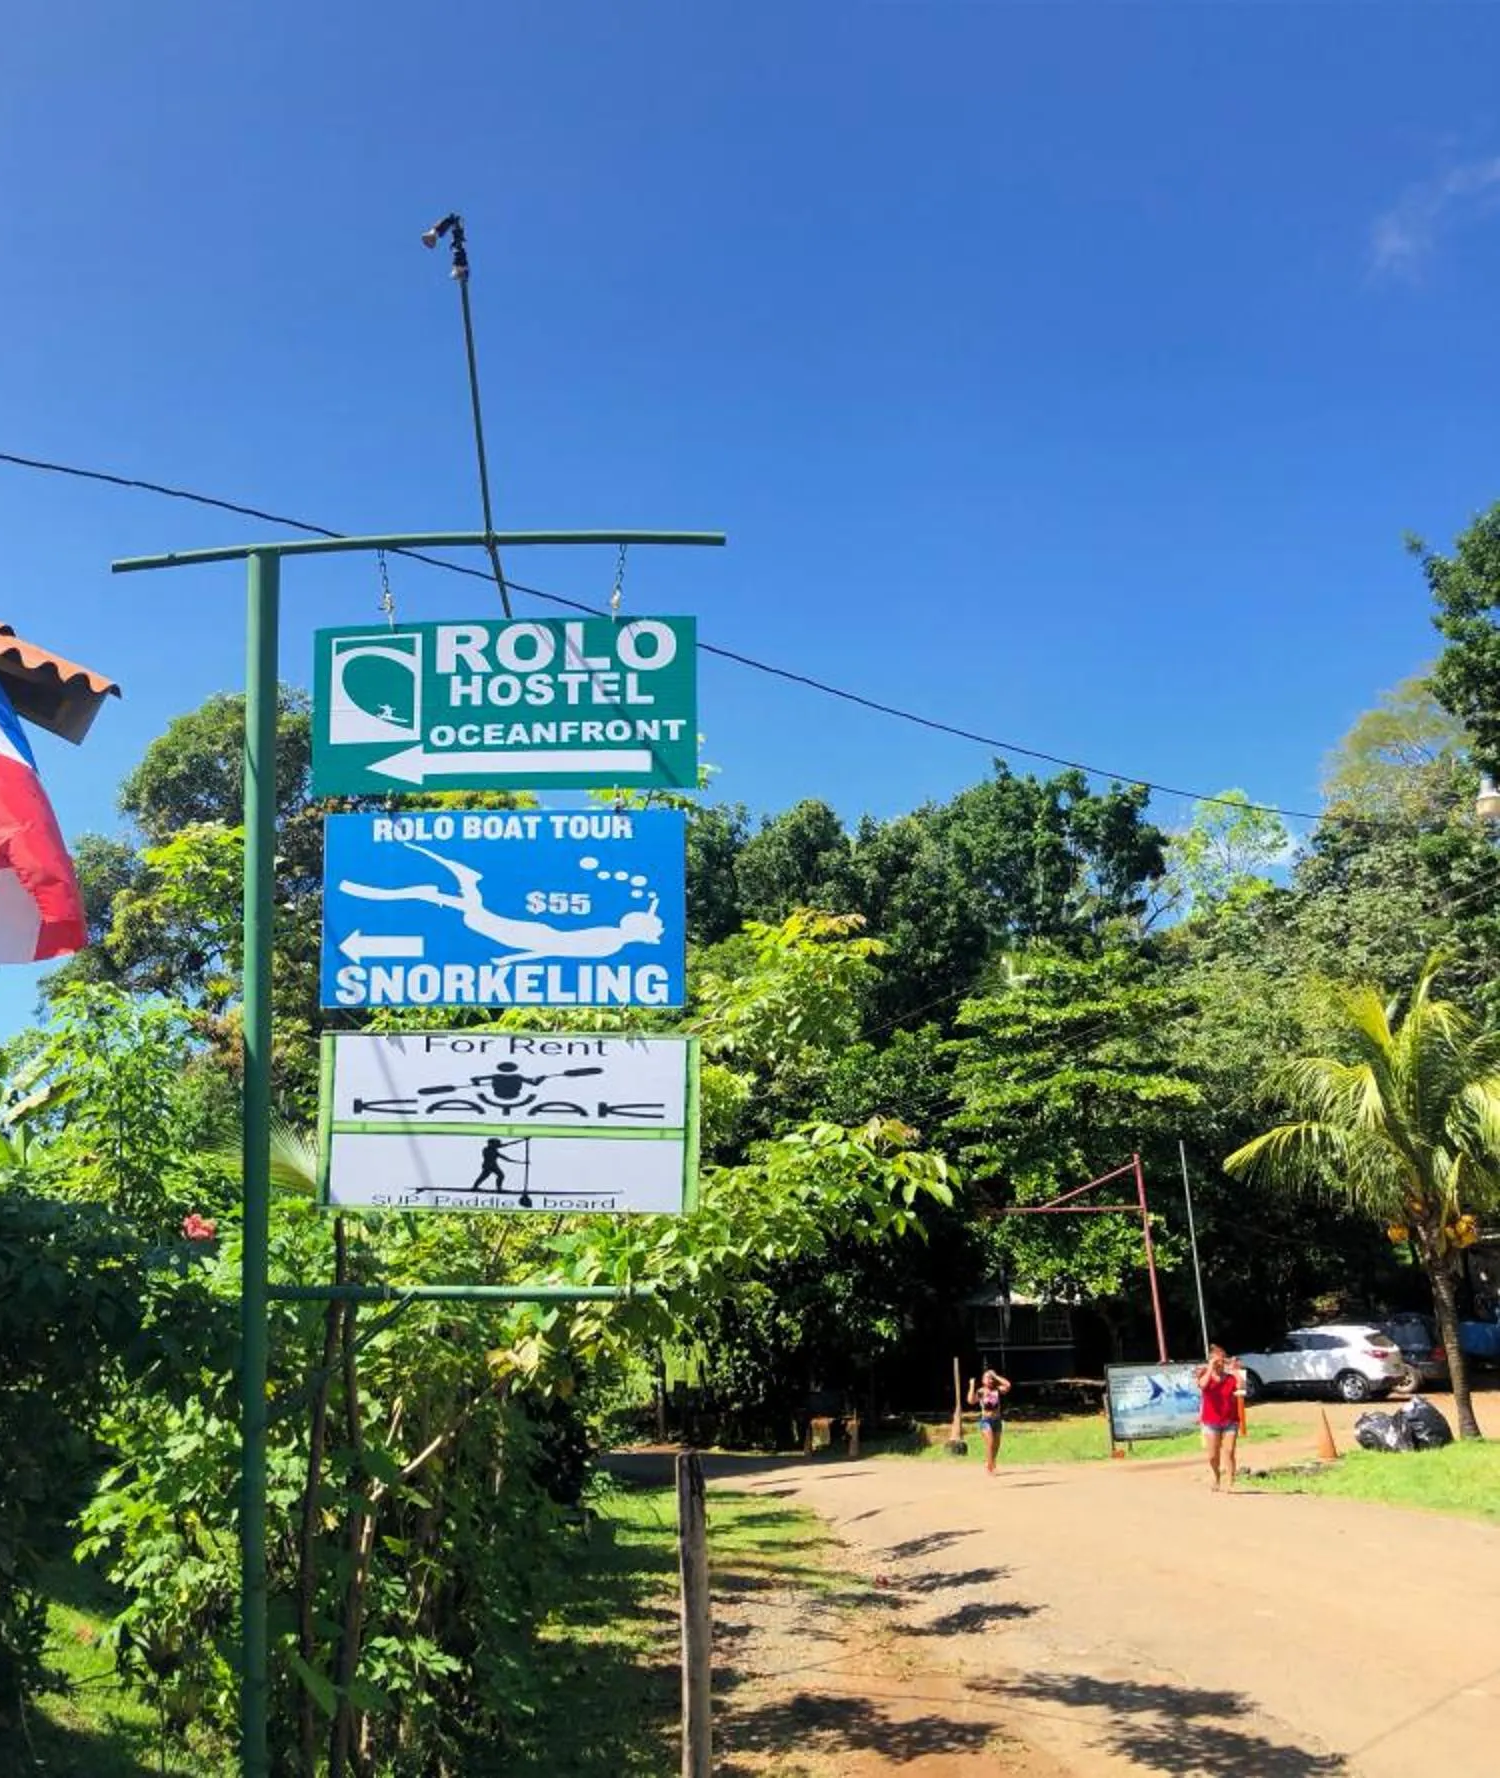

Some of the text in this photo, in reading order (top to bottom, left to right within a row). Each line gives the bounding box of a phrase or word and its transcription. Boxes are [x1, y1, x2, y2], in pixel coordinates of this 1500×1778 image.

[435, 619, 678, 674] ROLO
[449, 672, 655, 707] HOSTEL
[428, 718, 687, 747] OCEANFRONT
[372, 814, 634, 843] ROLO BOAT TOUR
[525, 890, 592, 915] $55
[334, 963, 669, 1006] SNORKELING
[424, 1034, 609, 1057] For Rent
[352, 1093, 666, 1119] KAYAK
[371, 1194, 615, 1210] SUP Paddle board
